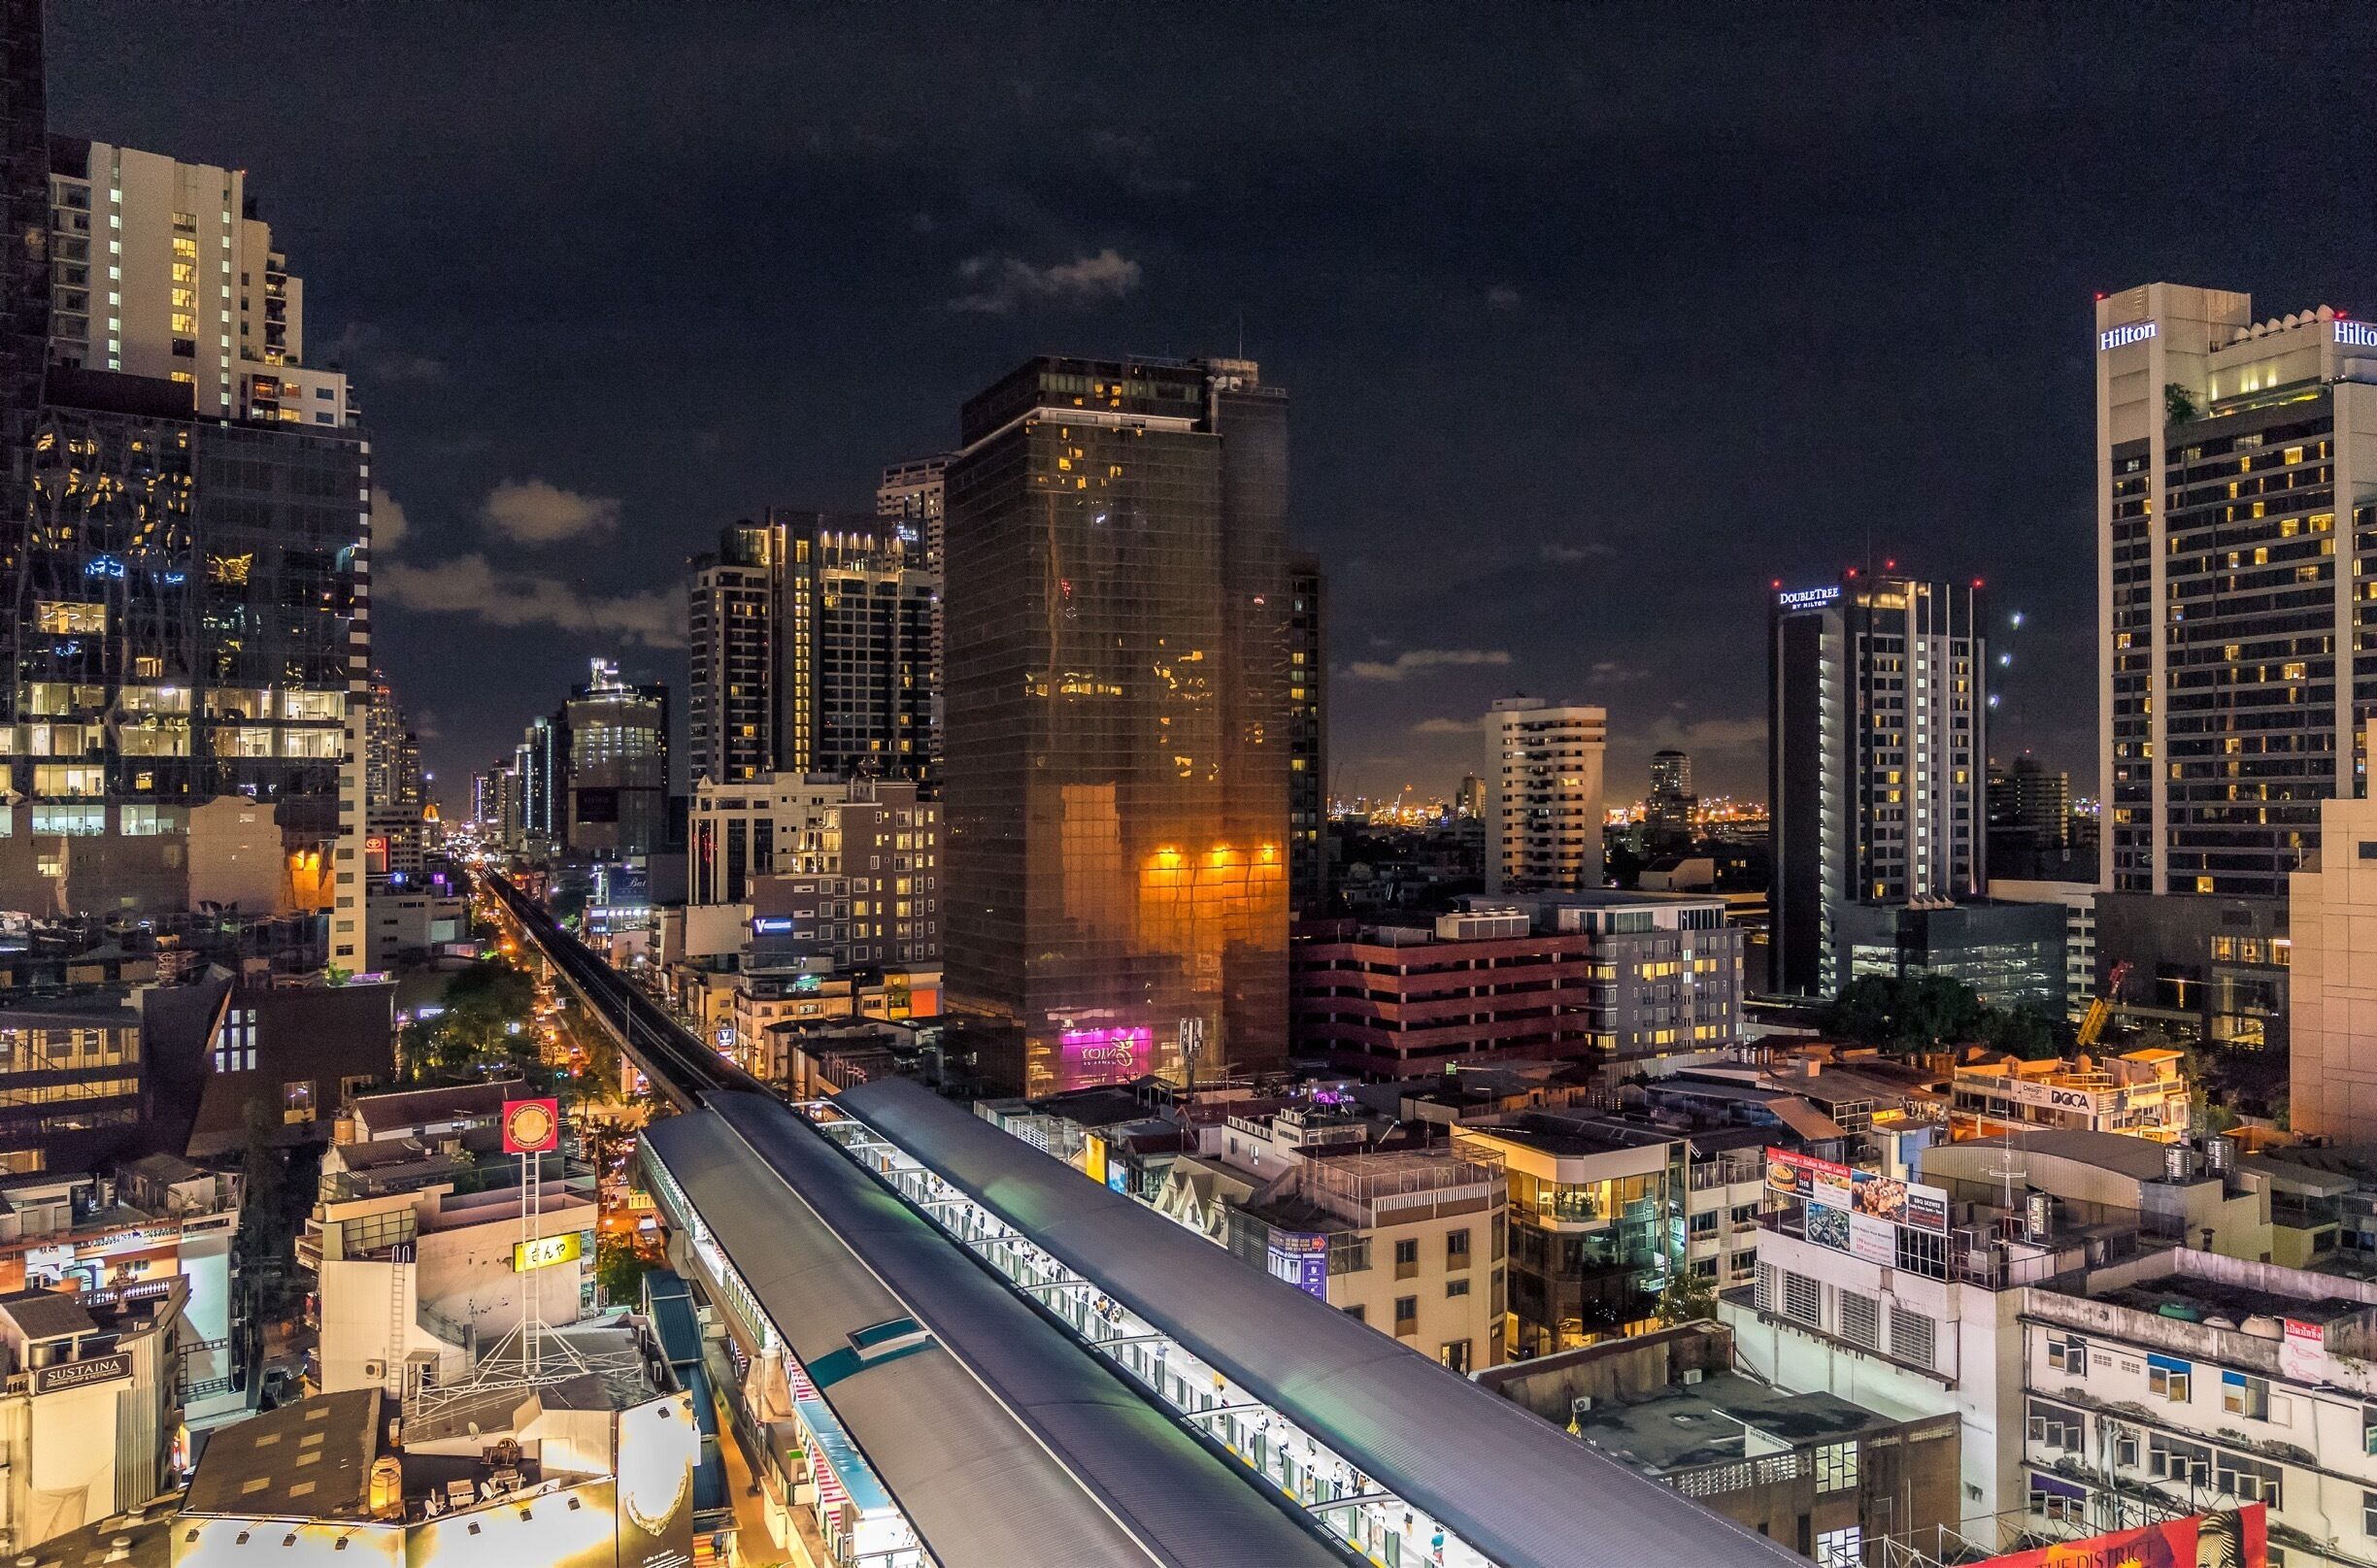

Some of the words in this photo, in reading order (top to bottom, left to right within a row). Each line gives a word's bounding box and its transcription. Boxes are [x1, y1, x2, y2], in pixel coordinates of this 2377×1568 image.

[2100, 323, 2157, 350] Hilton
[2051, 1089, 2090, 1110] DOCA
[48, 1360, 119, 1380] SUSTAINA
